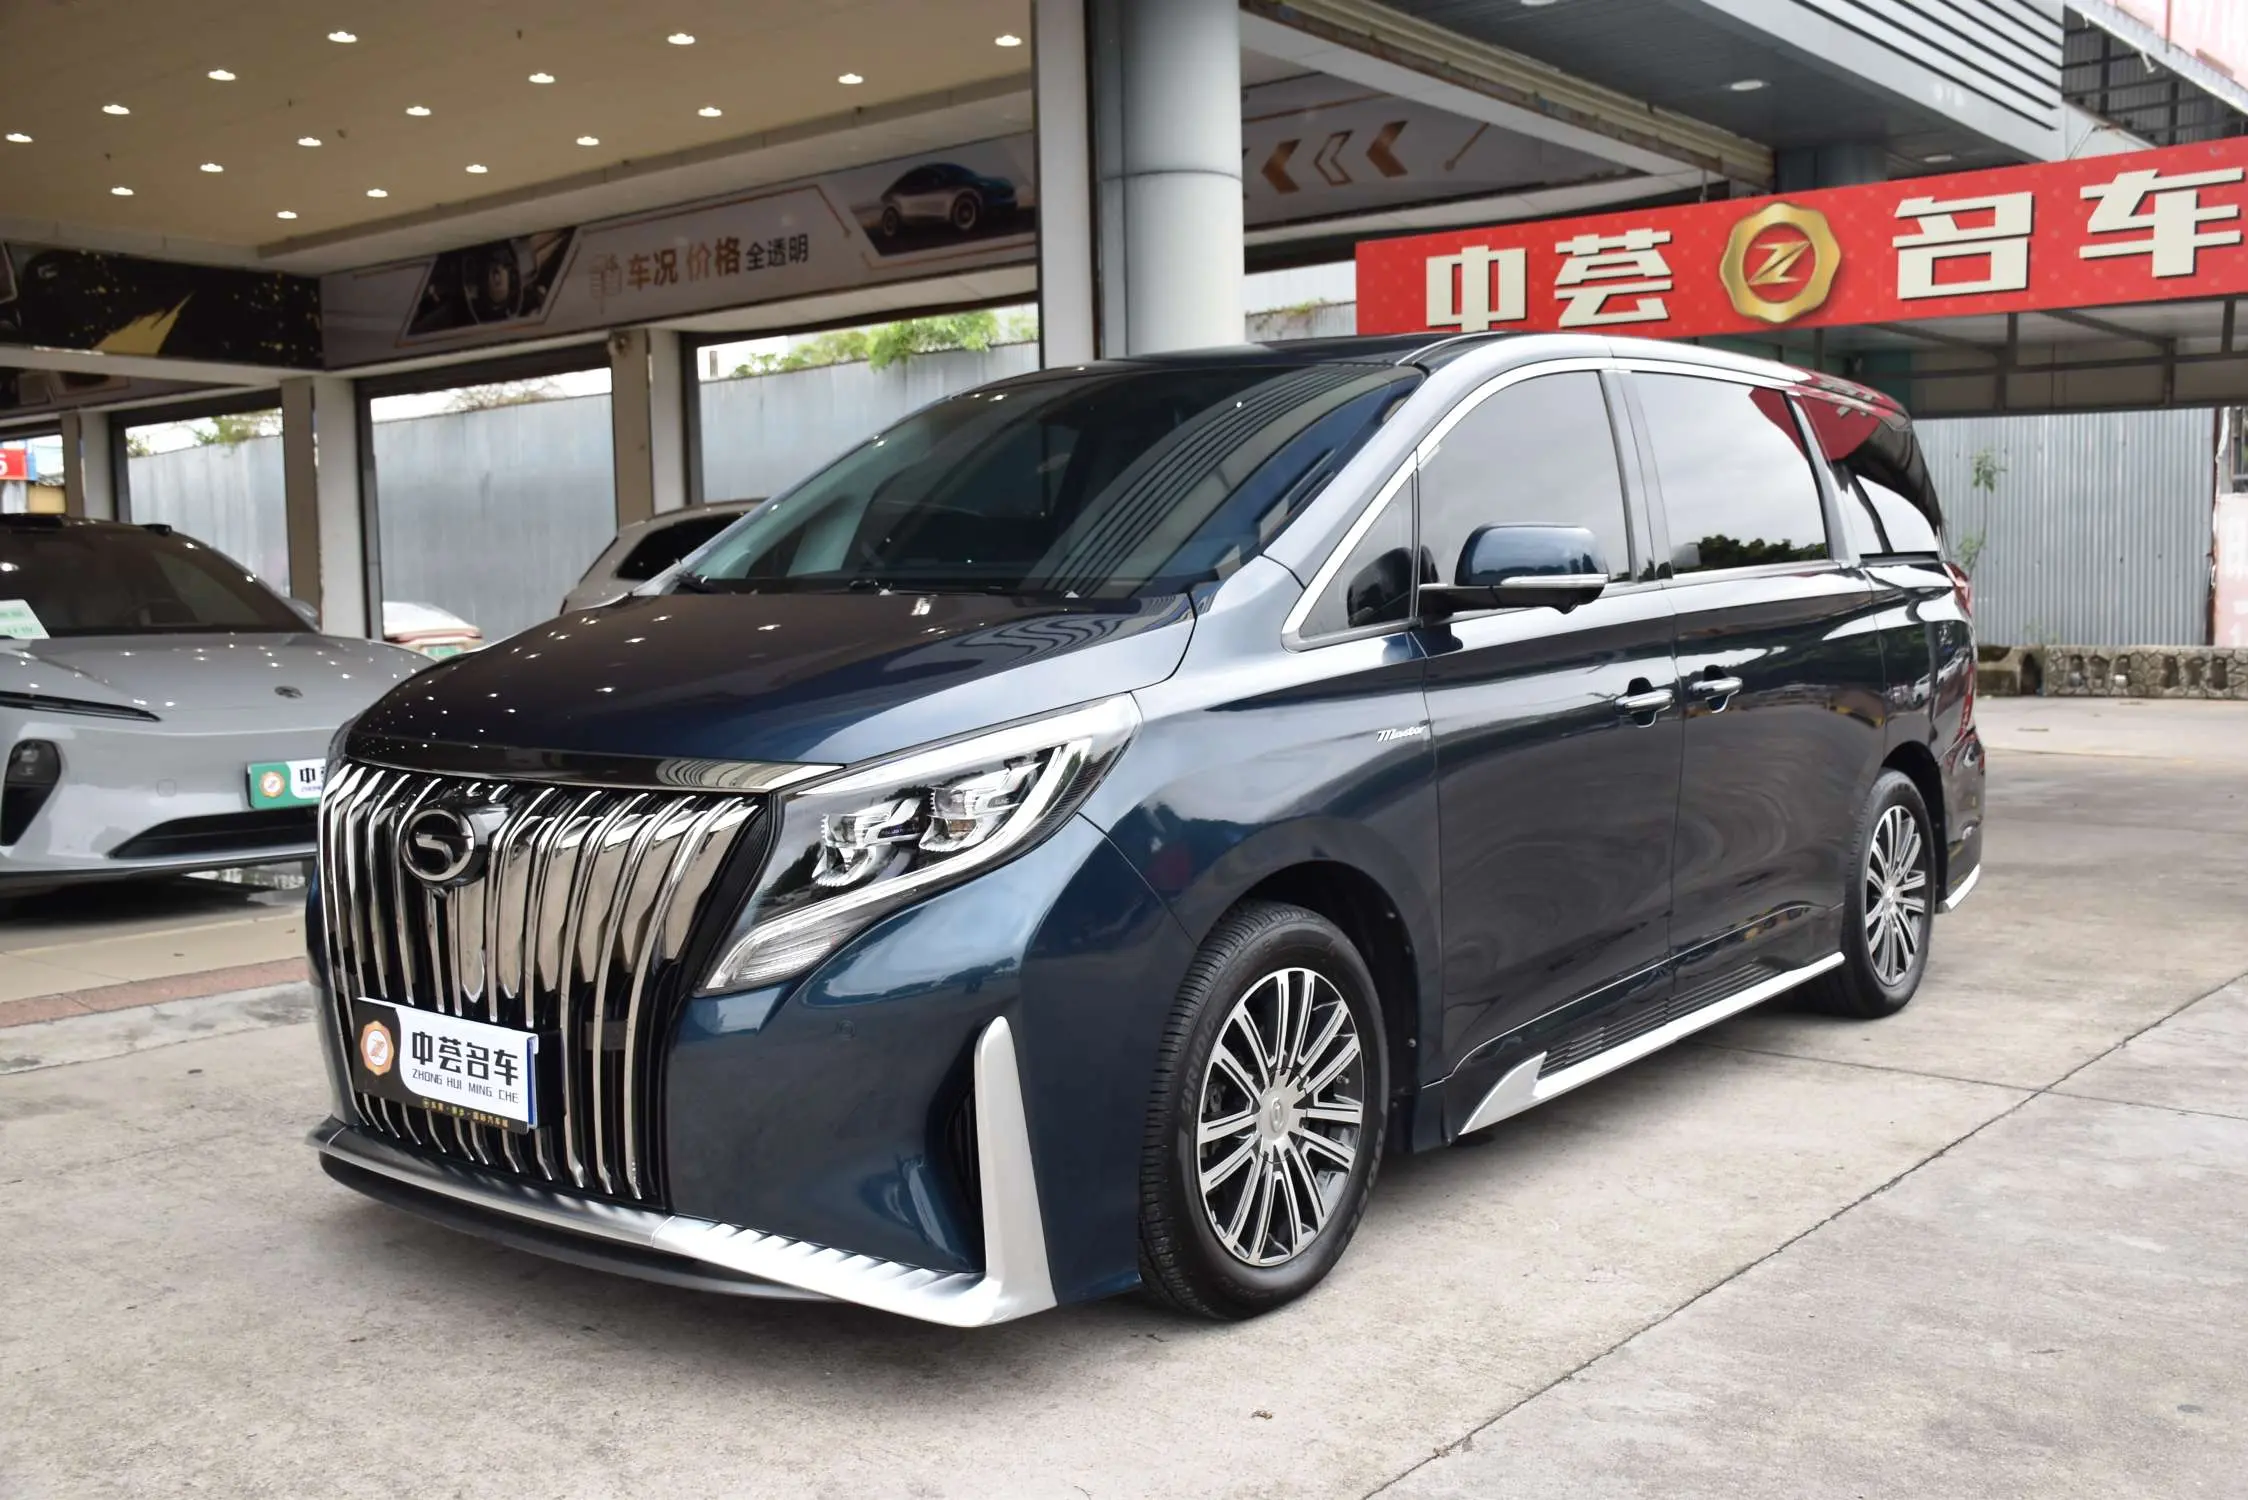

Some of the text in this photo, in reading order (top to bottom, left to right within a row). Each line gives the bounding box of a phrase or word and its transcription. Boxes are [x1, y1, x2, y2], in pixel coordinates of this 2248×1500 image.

[627, 233, 808, 291] 车况 价格 全透明
[1426, 228, 1673, 332] 中荟
[1893, 167, 2243, 299] 名车
[412, 1031, 519, 1086] 中荟名车
[412, 1068, 519, 1104] ZHONG HUI MING CHE
